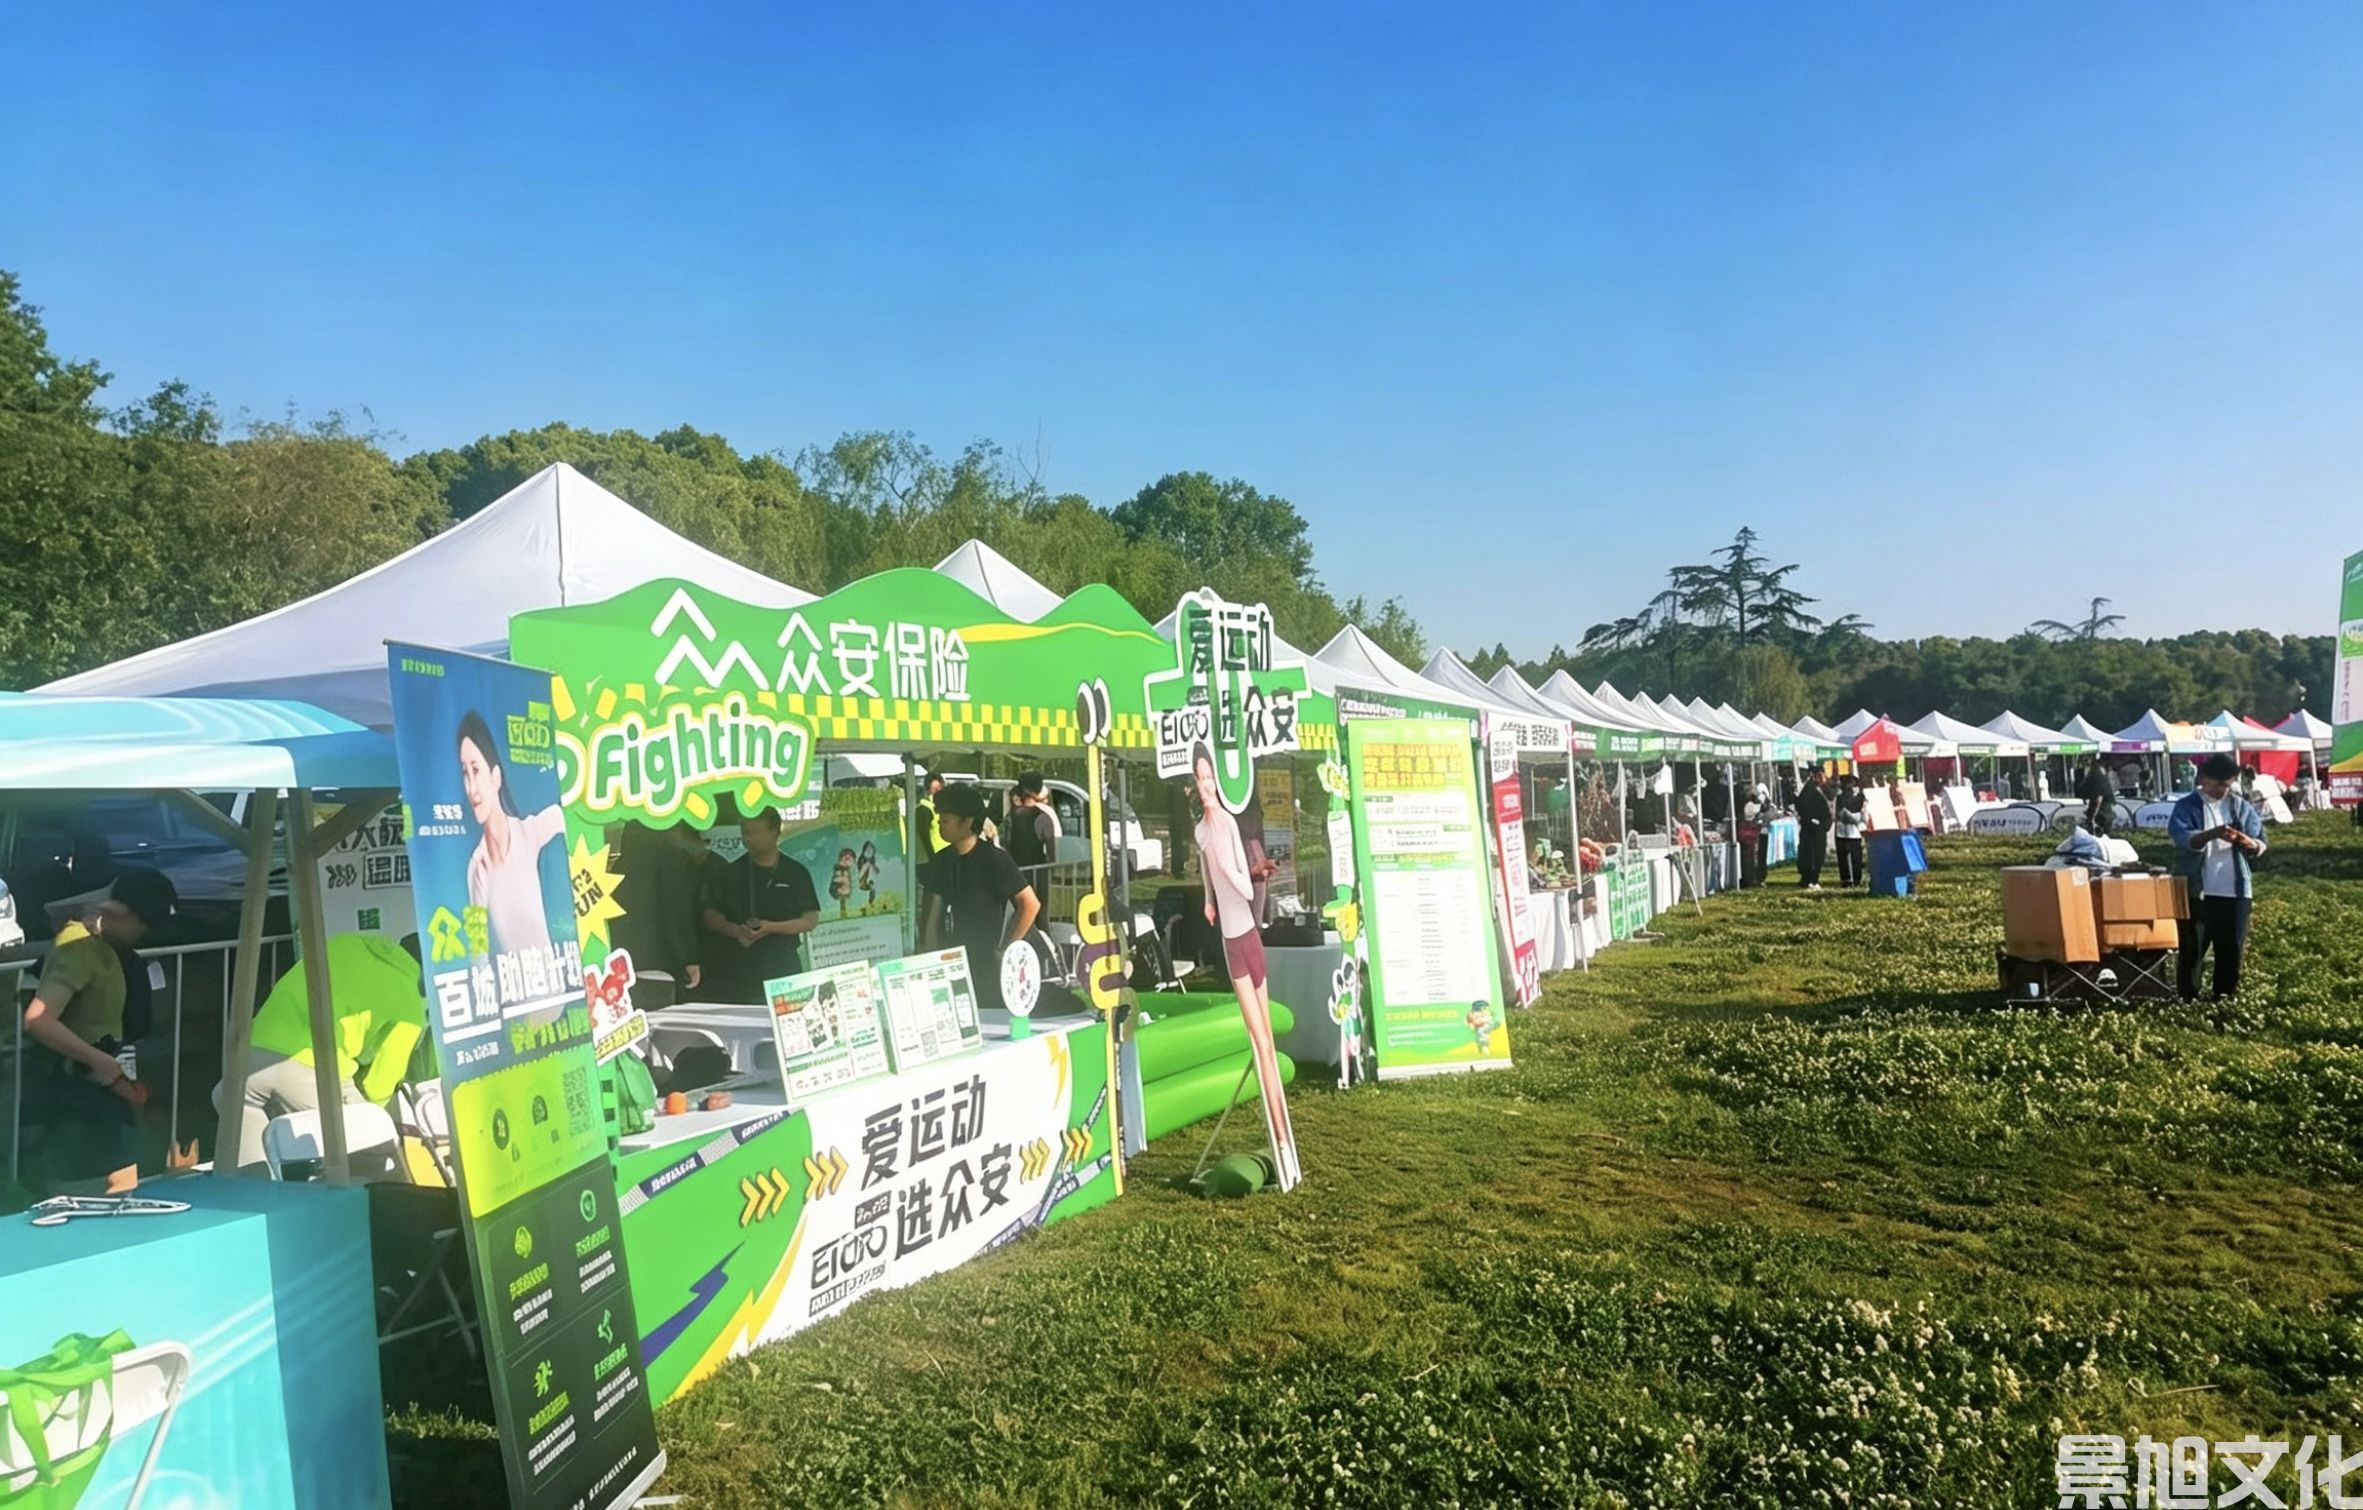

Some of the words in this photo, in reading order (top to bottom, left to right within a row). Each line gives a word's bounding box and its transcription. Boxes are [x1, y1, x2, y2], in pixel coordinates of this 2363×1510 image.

[777, 612, 971, 701] 众安保险
[1188, 610, 1272, 673] 爱运动
[595, 702, 803, 807] Fighting
[861, 1074, 987, 1190] 爱运动
[893, 1142, 1012, 1262] 选众安
